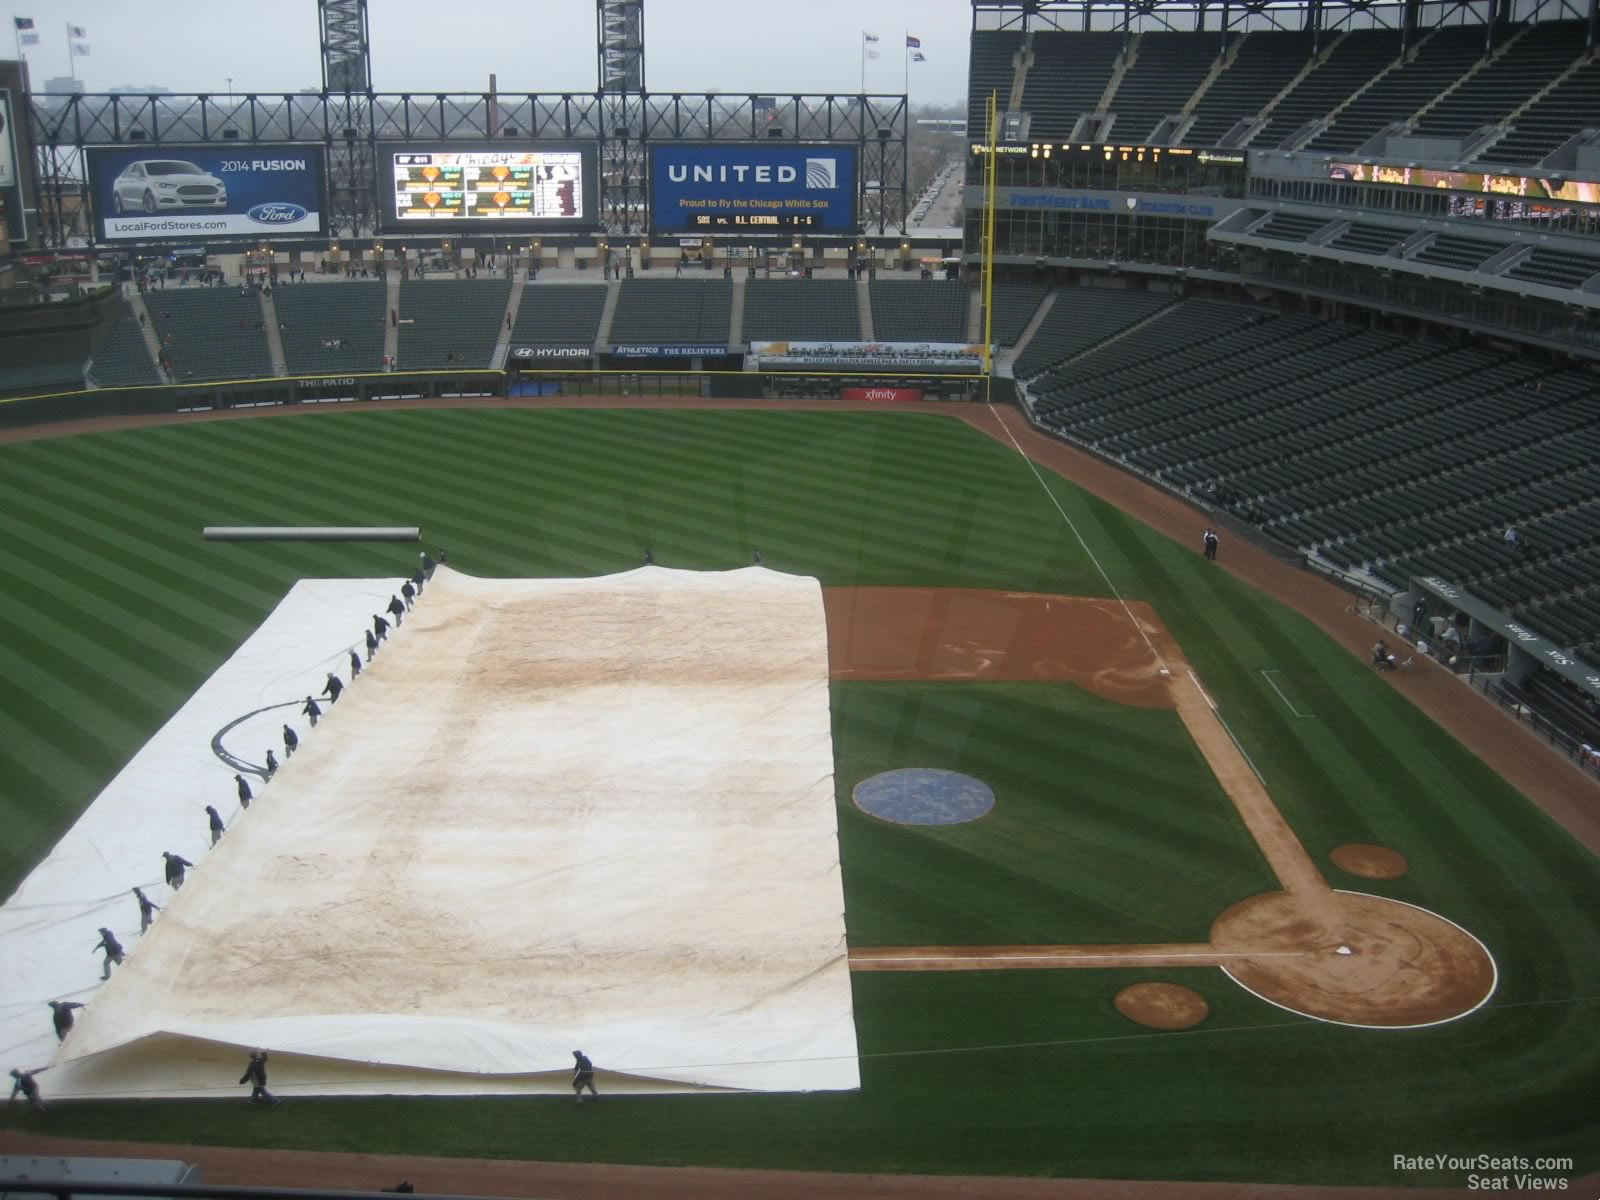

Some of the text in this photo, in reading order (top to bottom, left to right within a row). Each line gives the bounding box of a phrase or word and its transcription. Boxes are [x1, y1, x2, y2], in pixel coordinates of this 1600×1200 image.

[220, 160, 306, 172] 2014 FUSION
[668, 165, 797, 183] UNITED
[680, 200, 828, 208] Proud to fly the Chicago White Sox
[260, 206, 296, 222] Ford
[696, 216, 710, 224] SOX
[750, 216, 780, 224] CENTRAL
[115, 220, 226, 232] LocalFordStores.com
[322, 378, 354, 386] PATIO
[866, 389, 896, 400] xfinity
